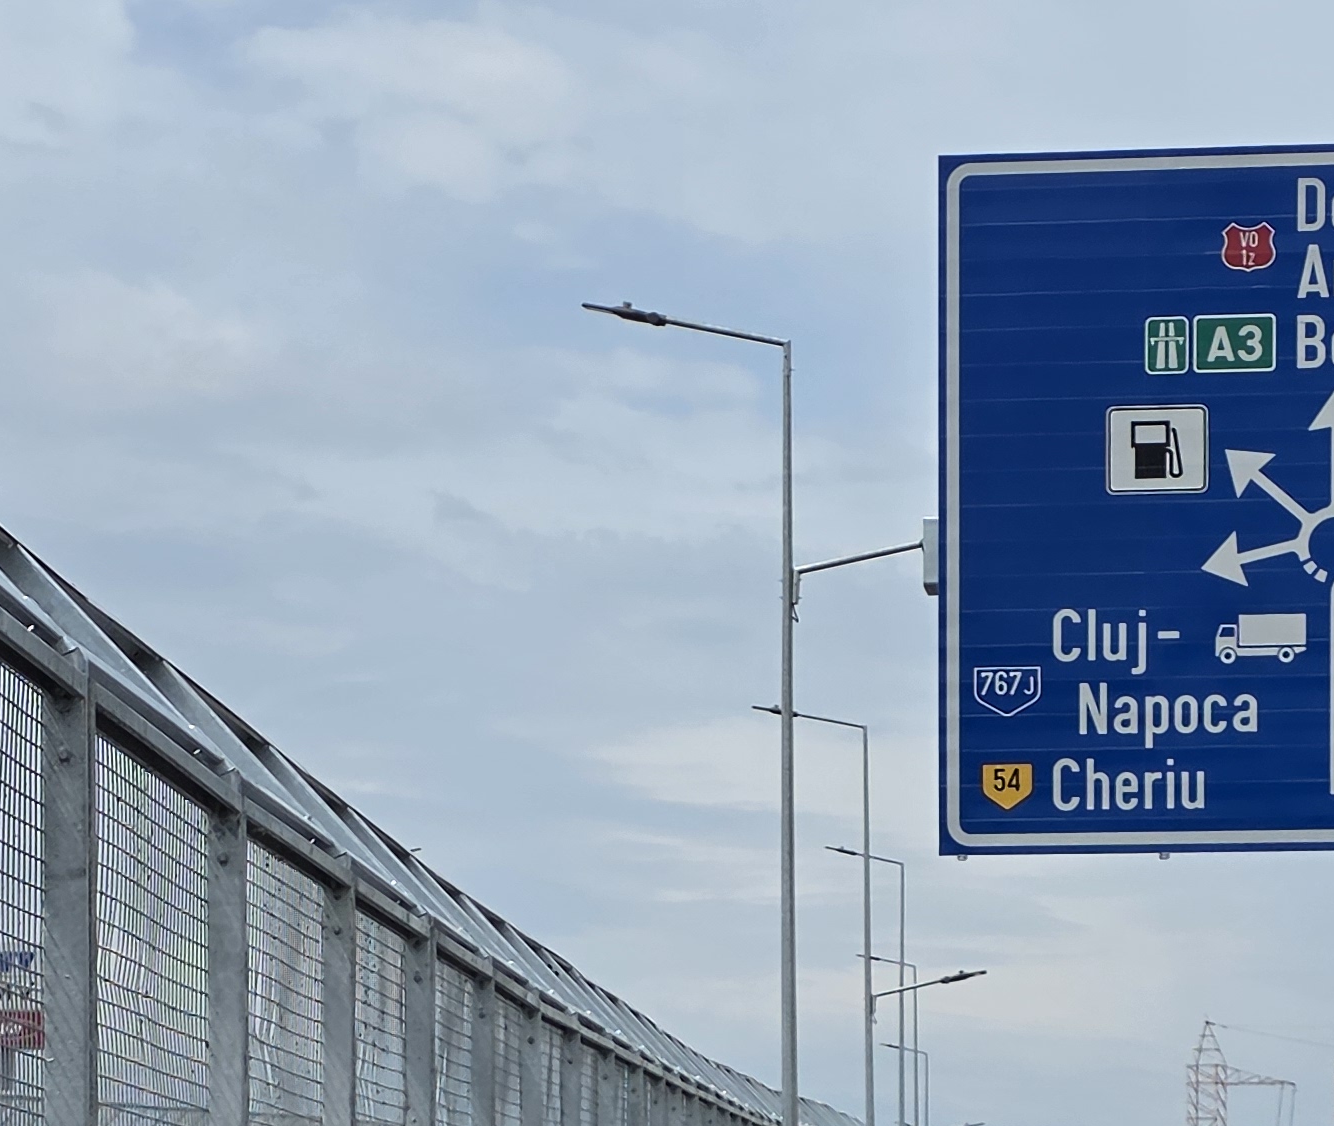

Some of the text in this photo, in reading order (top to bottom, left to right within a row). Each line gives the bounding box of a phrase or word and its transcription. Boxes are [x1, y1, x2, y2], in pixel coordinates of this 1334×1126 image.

[1207, 324, 1263, 363] A3
[1052, 608, 1180, 675] Cluj-
[980, 671, 1035, 697] 767J
[1078, 682, 1258, 749] Napoca
[993, 768, 1020, 791] 54
[1052, 757, 1205, 811] Cheriu
